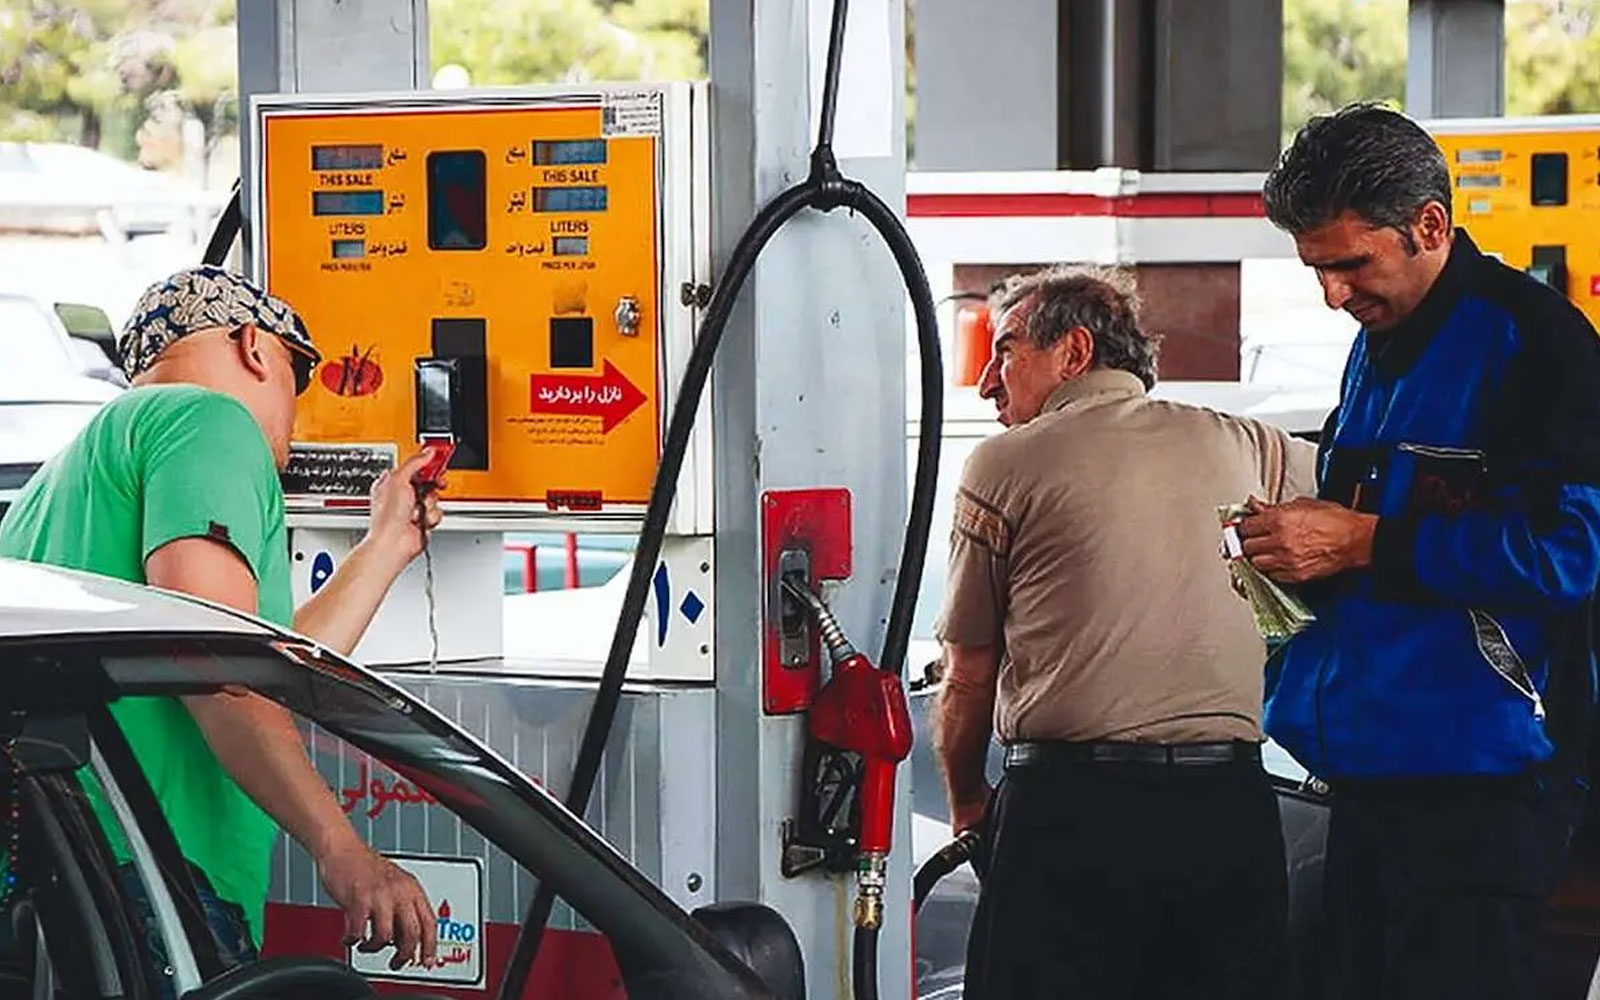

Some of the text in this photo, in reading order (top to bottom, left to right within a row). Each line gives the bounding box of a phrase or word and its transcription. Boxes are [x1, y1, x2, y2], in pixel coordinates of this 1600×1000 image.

[320, 174, 373, 186] THIS SALE
[544, 170, 598, 182] THIS SALE
[329, 223, 366, 235] LITERS
[550, 221, 589, 233] LITERS
[584, 385, 596, 403] را
[597, 385, 623, 404] نازل
[437, 917, 475, 942] TRO
